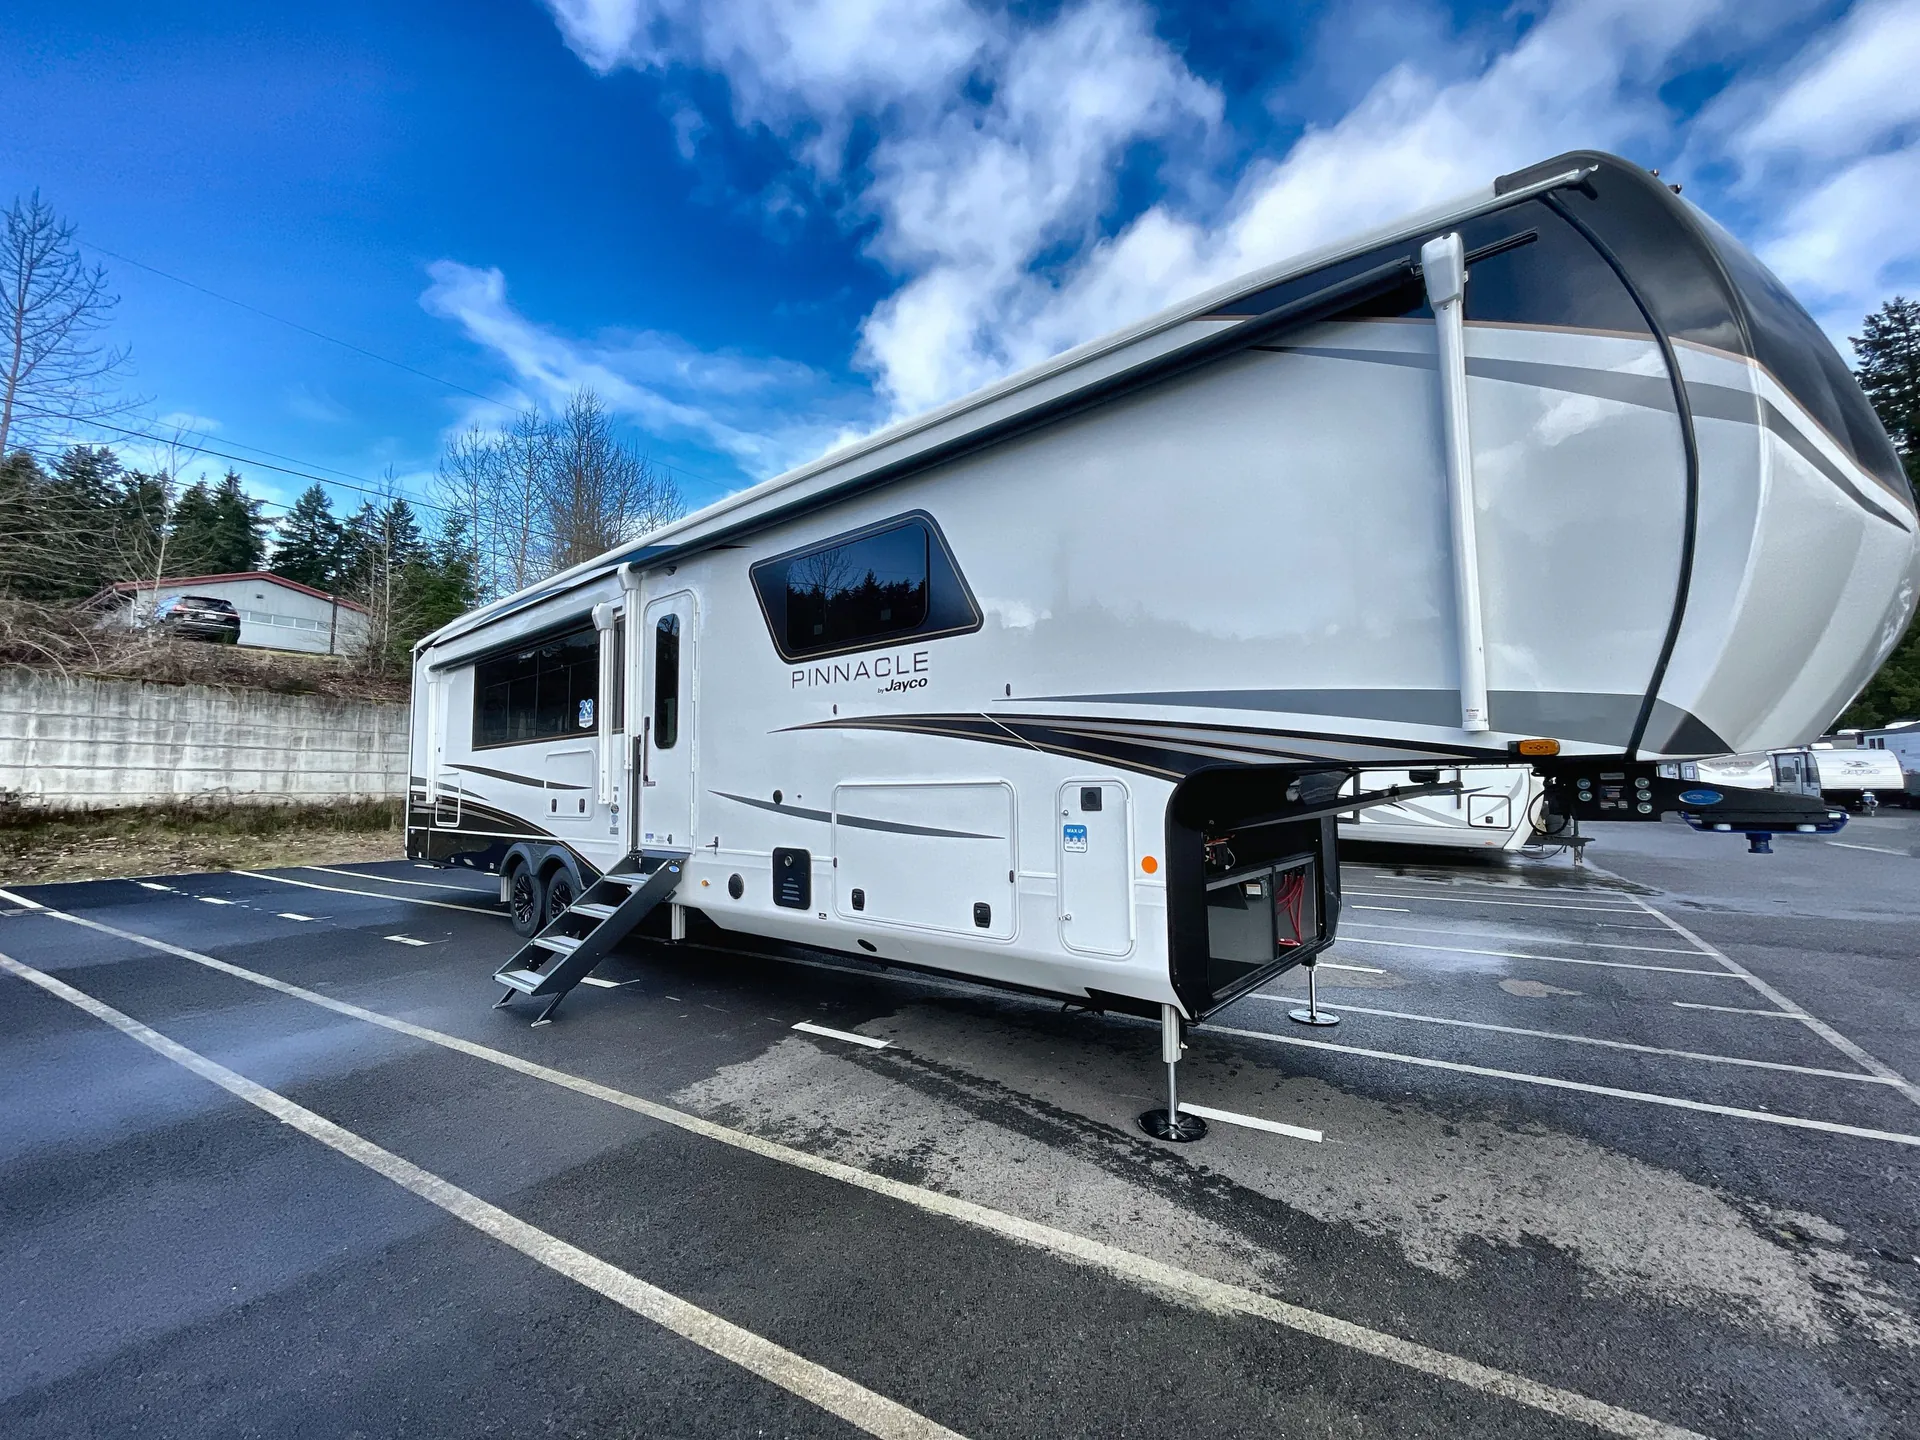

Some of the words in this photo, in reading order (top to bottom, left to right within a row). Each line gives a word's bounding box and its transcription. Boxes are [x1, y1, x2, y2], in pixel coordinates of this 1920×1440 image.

[792, 651, 928, 688] PINNACLE
[885, 678, 928, 692] Jayco
[580, 699, 594, 716] 23
